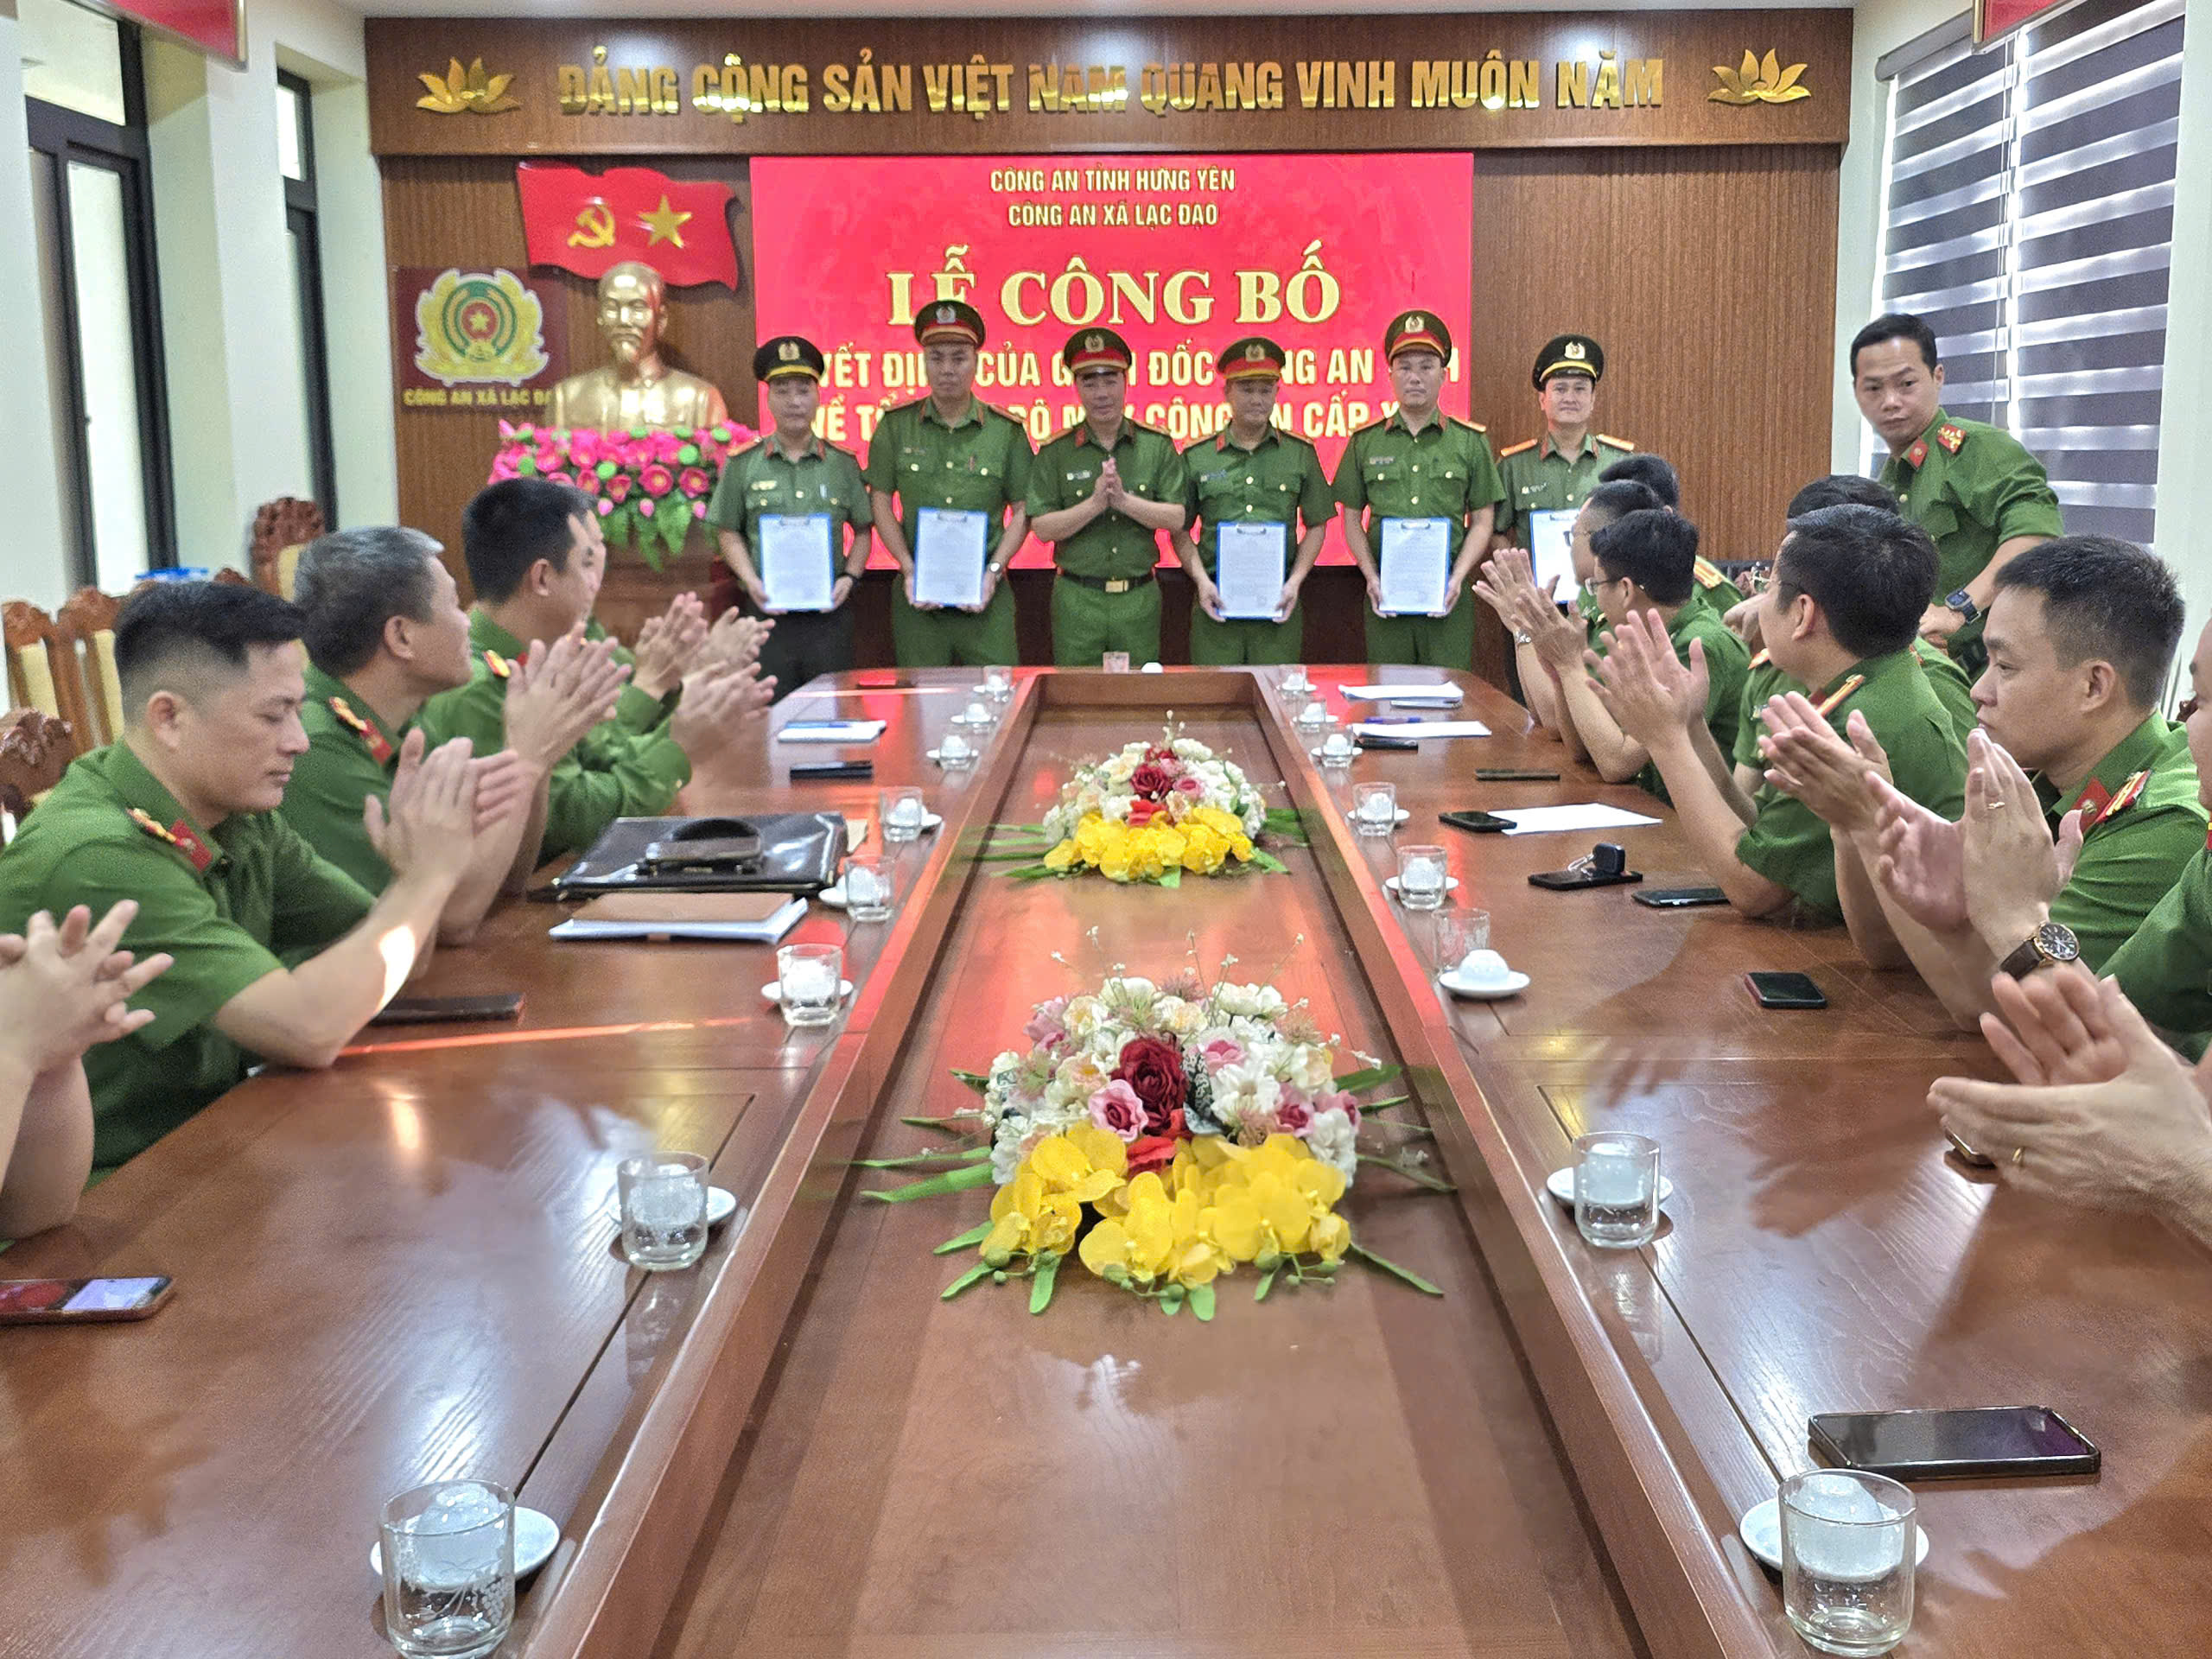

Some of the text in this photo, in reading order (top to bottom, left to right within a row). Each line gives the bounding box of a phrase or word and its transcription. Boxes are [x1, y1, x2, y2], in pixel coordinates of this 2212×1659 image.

[558, 46, 1664, 124] ĐẢNG CỘNG SẢN VIỆT NAM QUANG VINH MUÔN NĂM
[990, 162, 1236, 192] CÔNG AN TỈNH HƯNG YÊN
[1008, 199, 1217, 231] CÔNG AN XÃ LẠC ĐẠO
[1001, 254, 1215, 326] CÔNG
[1234, 239, 1340, 324] BỐ
[976, 340, 1041, 387] CỦA
[1147, 338, 1215, 386] ĐỐC
[1326, 347, 1374, 385] AN
[1303, 390, 1370, 437] CẤP
